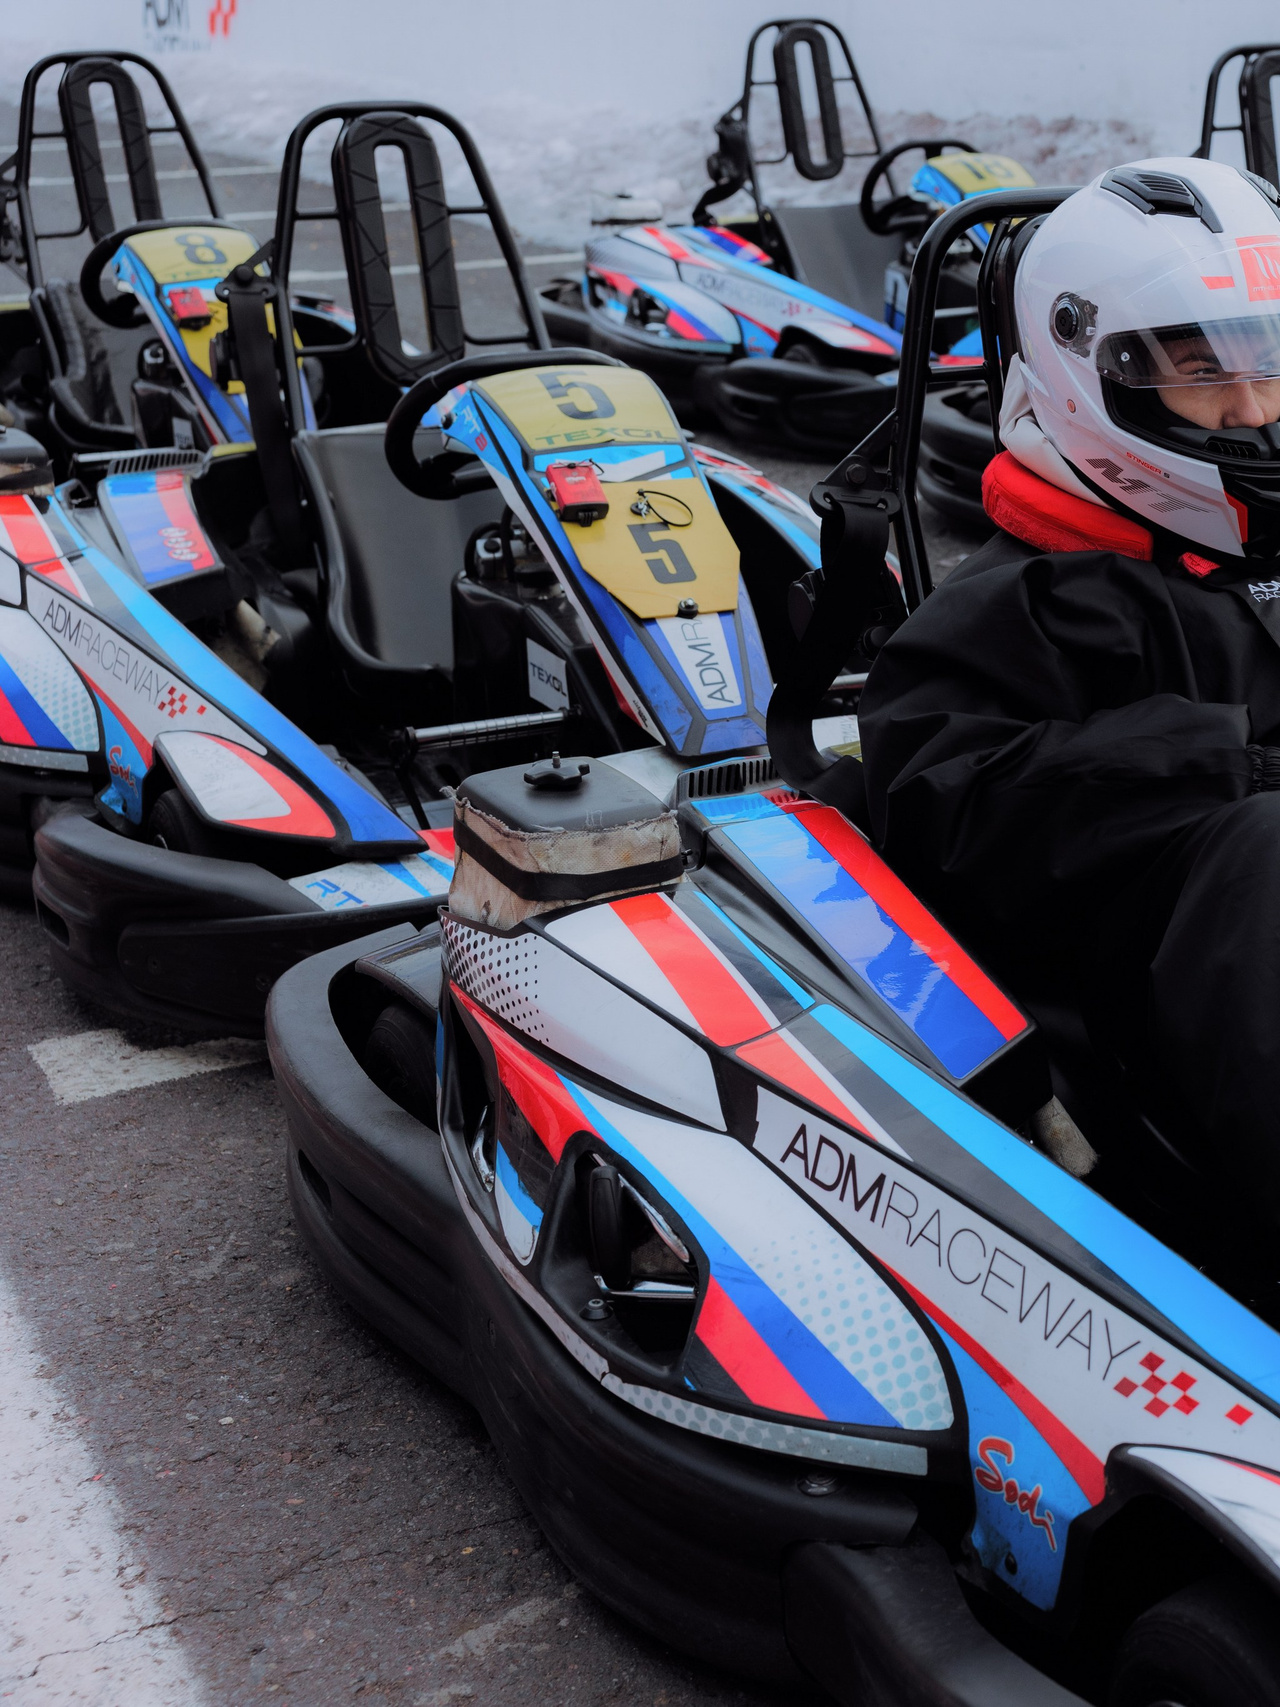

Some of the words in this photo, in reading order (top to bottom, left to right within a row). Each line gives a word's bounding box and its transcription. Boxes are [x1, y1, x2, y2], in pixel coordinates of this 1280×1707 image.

[175, 232, 227, 265] 8
[535, 370, 616, 420] 5
[1085, 458, 1219, 514] MT
[1126, 451, 1162, 475] STINGER
[627, 521, 697, 584] 5
[43, 598, 169, 706] ADMRACEWAY
[305, 878, 370, 908] RT
[779, 1122, 1142, 1381] ADMRACEWAY
[975, 1436, 1057, 1552] Sodi
